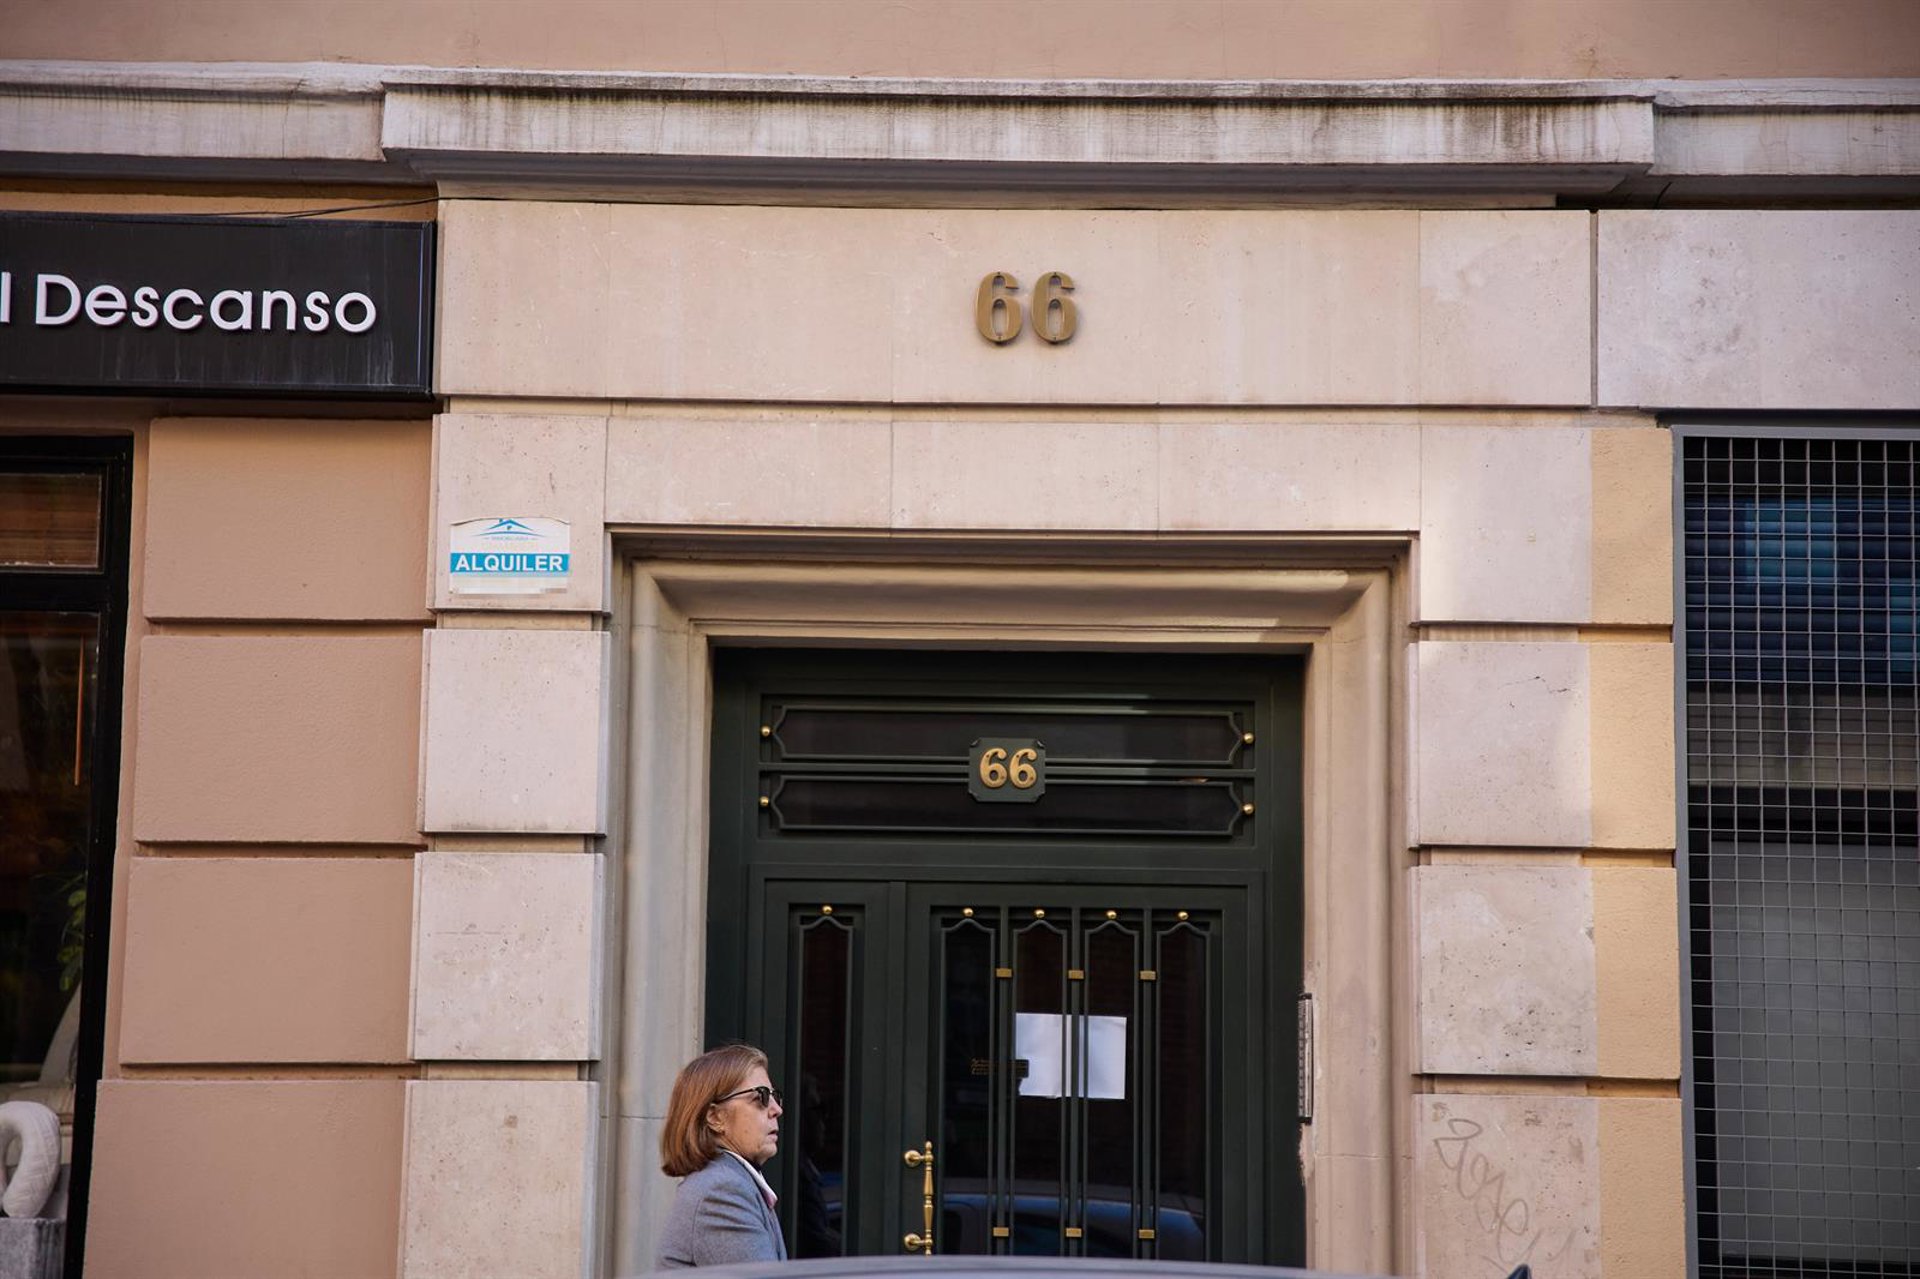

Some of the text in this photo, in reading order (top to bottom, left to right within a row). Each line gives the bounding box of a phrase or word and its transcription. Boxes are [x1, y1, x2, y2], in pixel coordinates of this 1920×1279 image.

[35, 273, 378, 334] Descanso
[975, 271, 1078, 345] 66
[455, 554, 564, 572] ALQUILER
[980, 747, 1038, 789] 66
